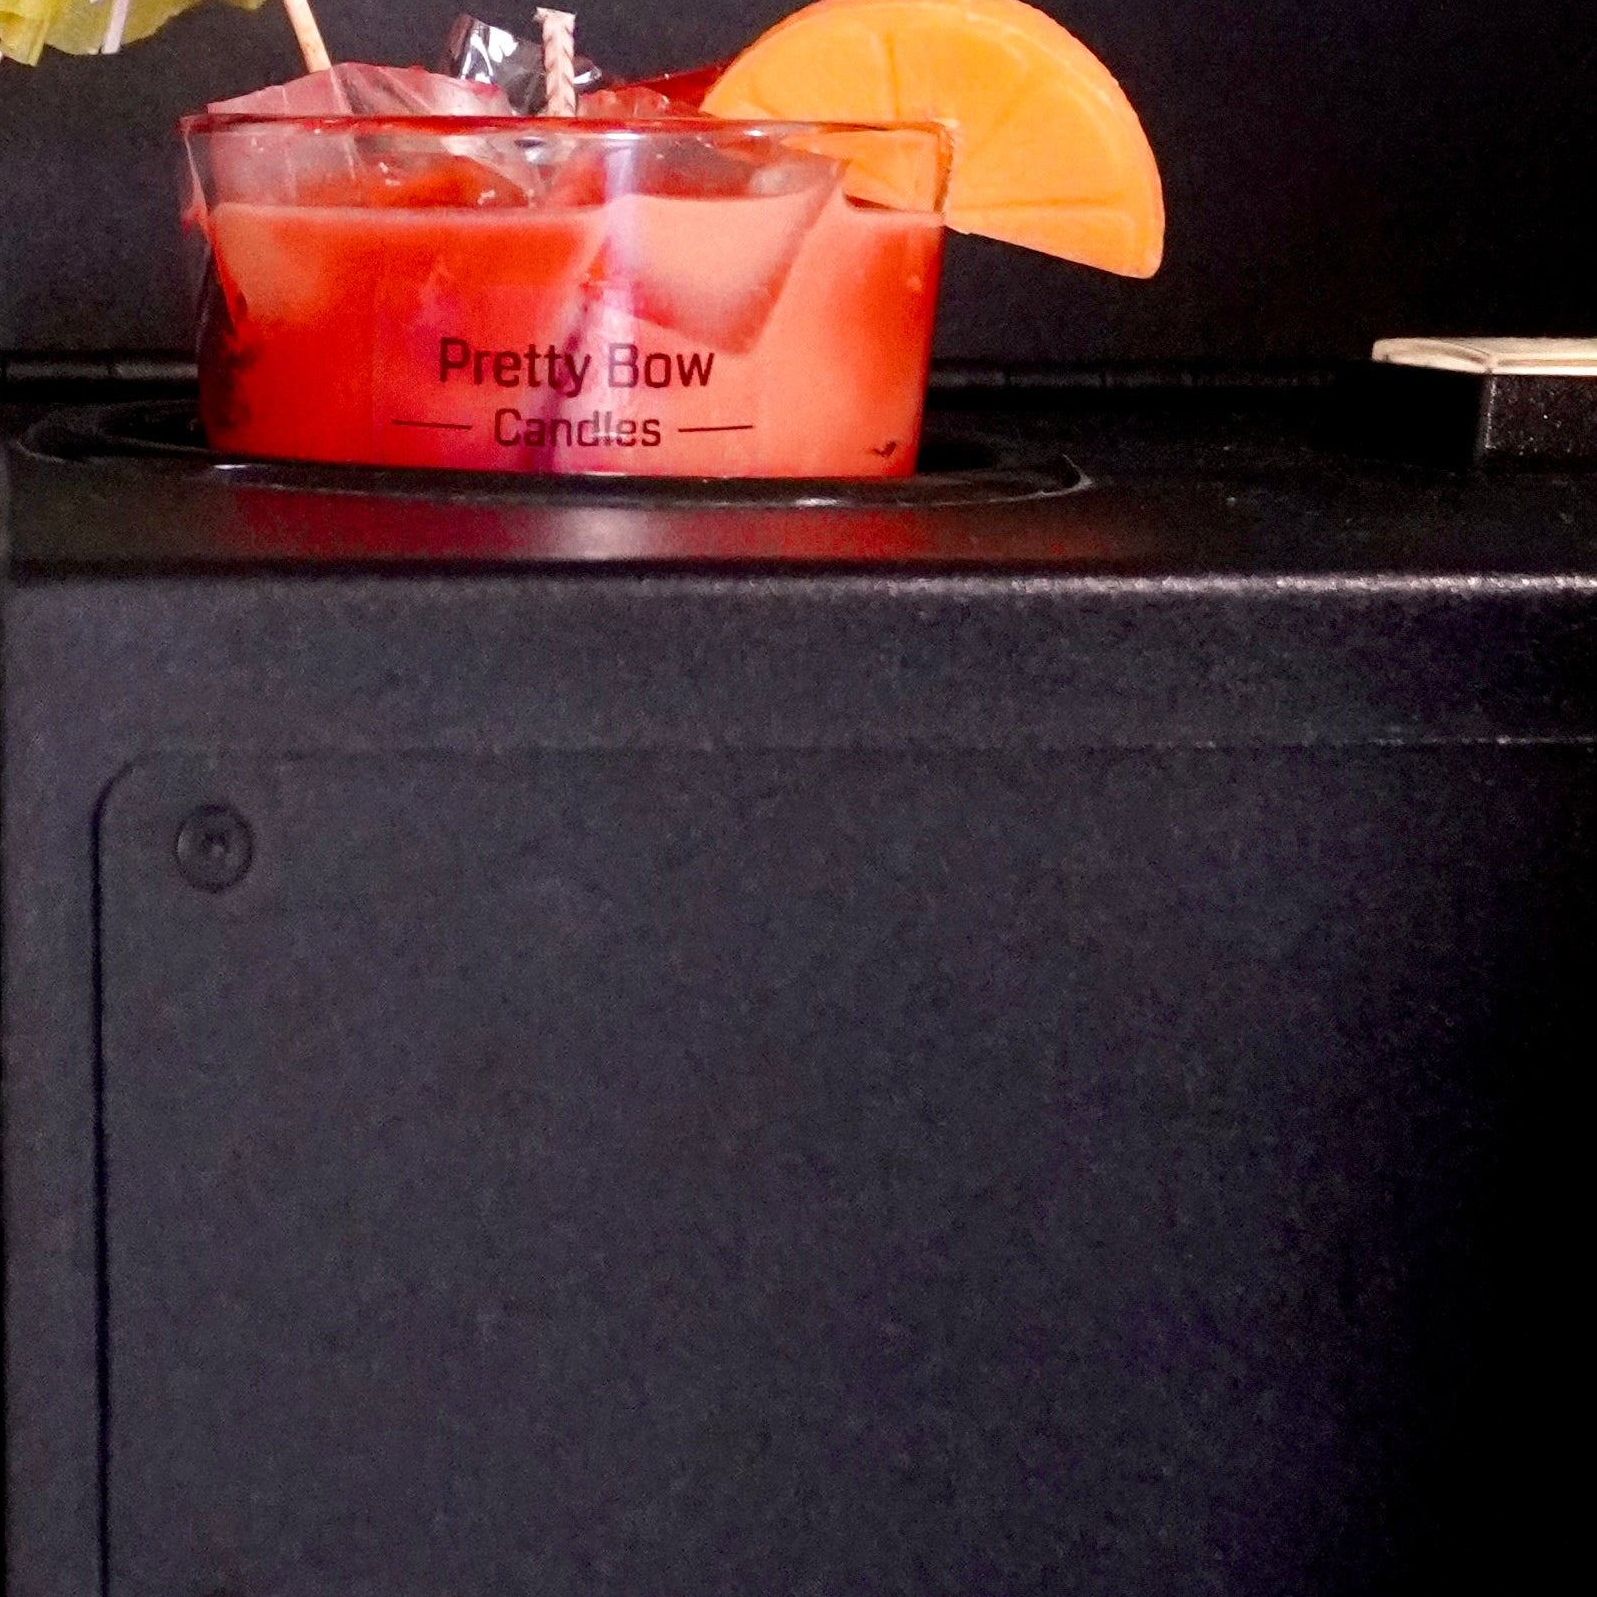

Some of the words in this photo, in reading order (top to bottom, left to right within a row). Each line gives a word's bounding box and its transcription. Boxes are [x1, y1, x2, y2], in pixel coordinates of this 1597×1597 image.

[439, 337, 591, 398] Pretty
[607, 342, 714, 388] Bow
[494, 408, 662, 447] Candles
